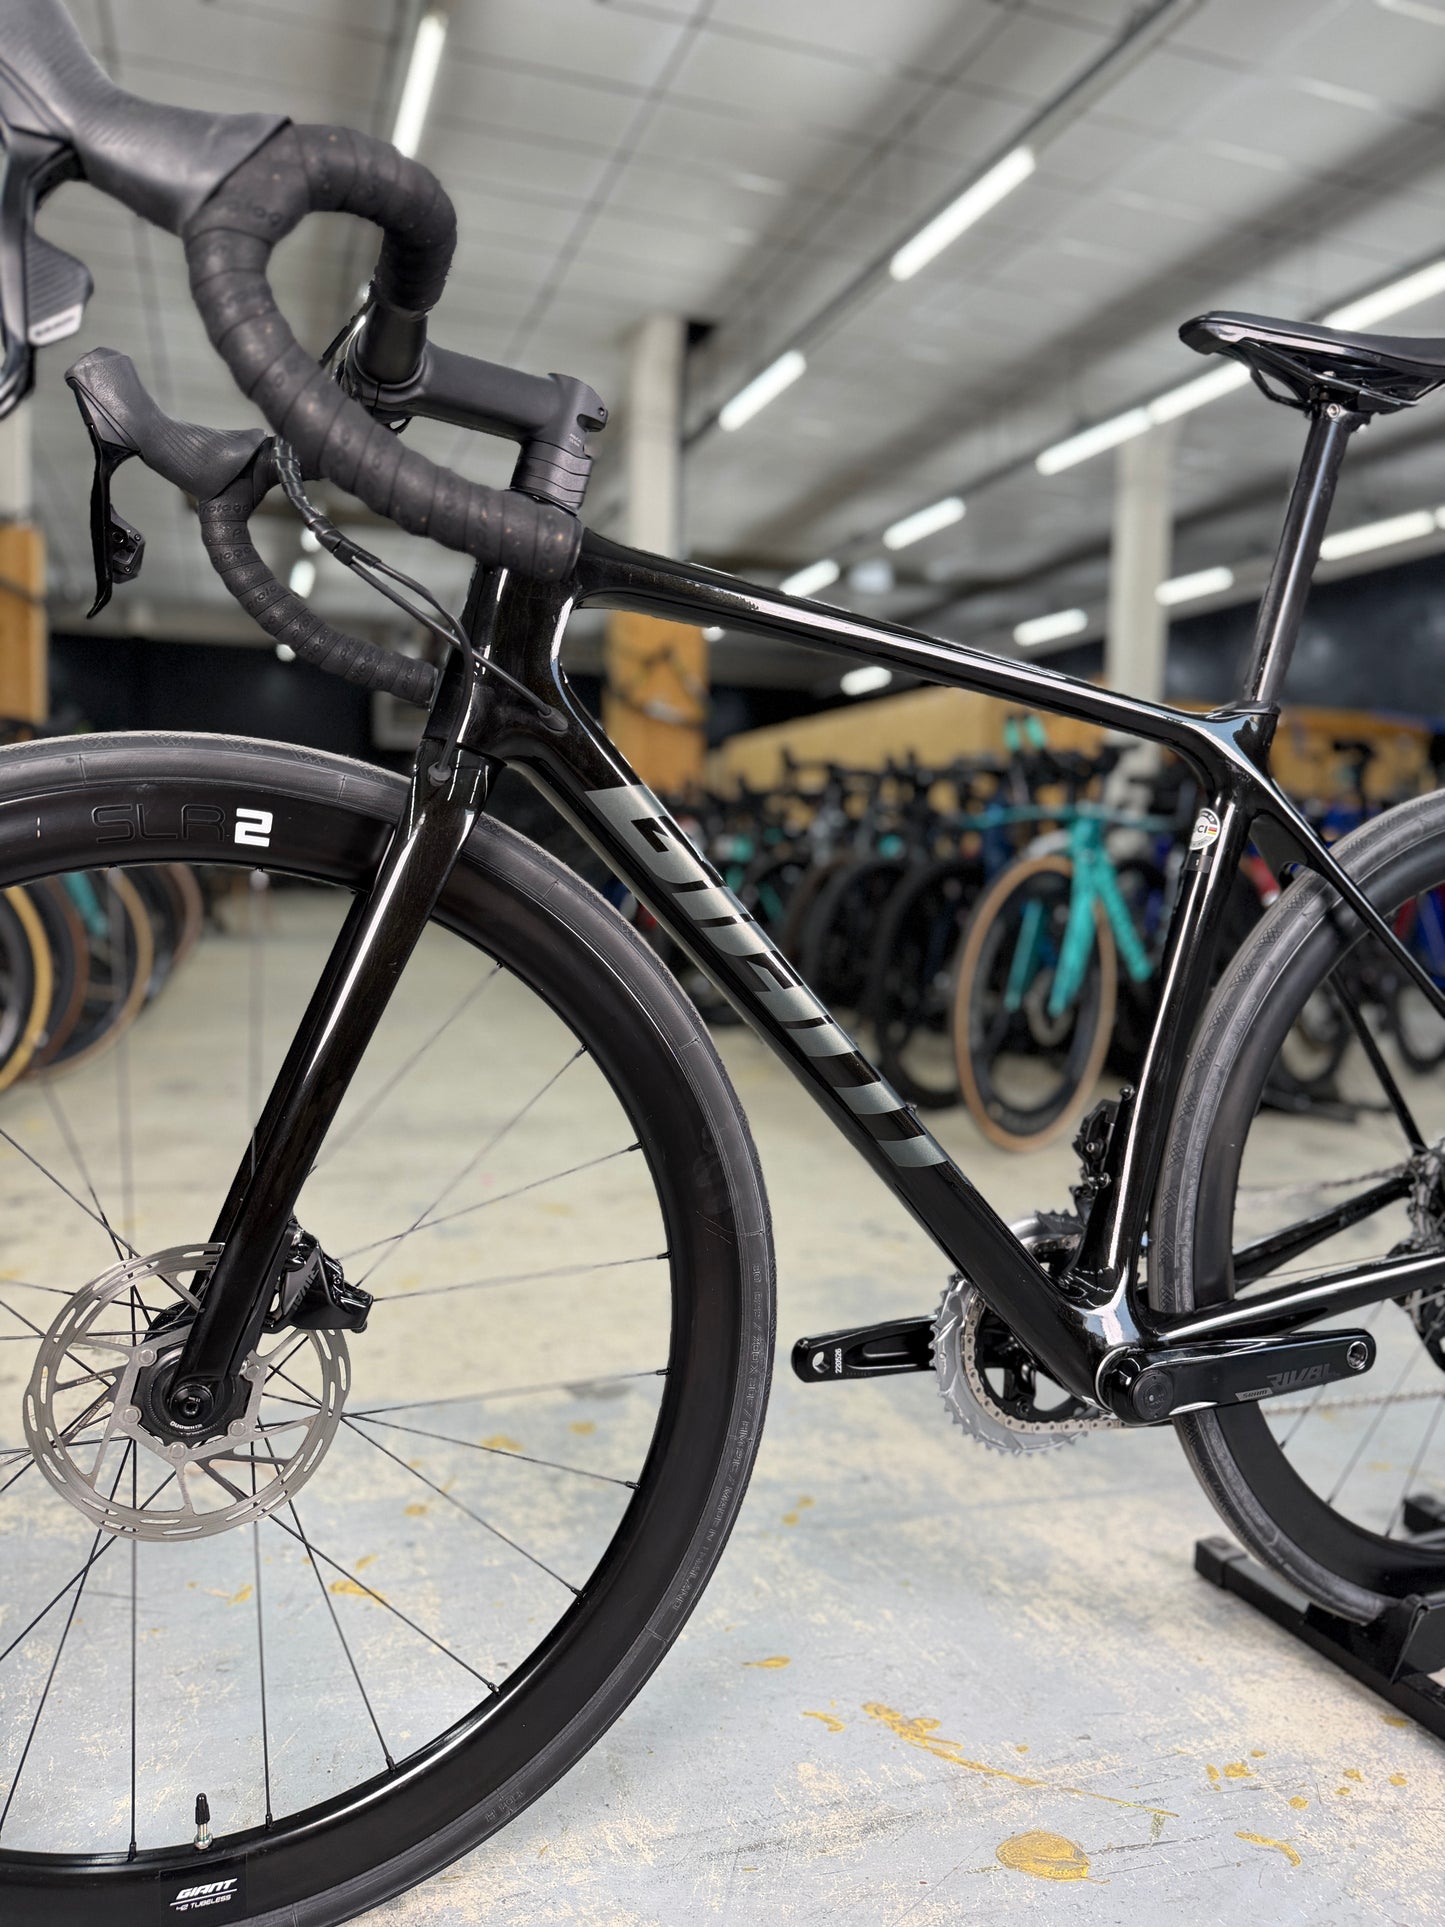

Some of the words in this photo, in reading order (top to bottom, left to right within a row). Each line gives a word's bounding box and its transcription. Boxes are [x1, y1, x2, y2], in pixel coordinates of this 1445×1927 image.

[92, 804, 225, 843] SLR
[234, 808, 273, 847] 2
[1267, 1363, 1338, 1388] RIVAL
[176, 1878, 237, 1900] GIANT
[190, 1894, 232, 1908] TUBELESS
